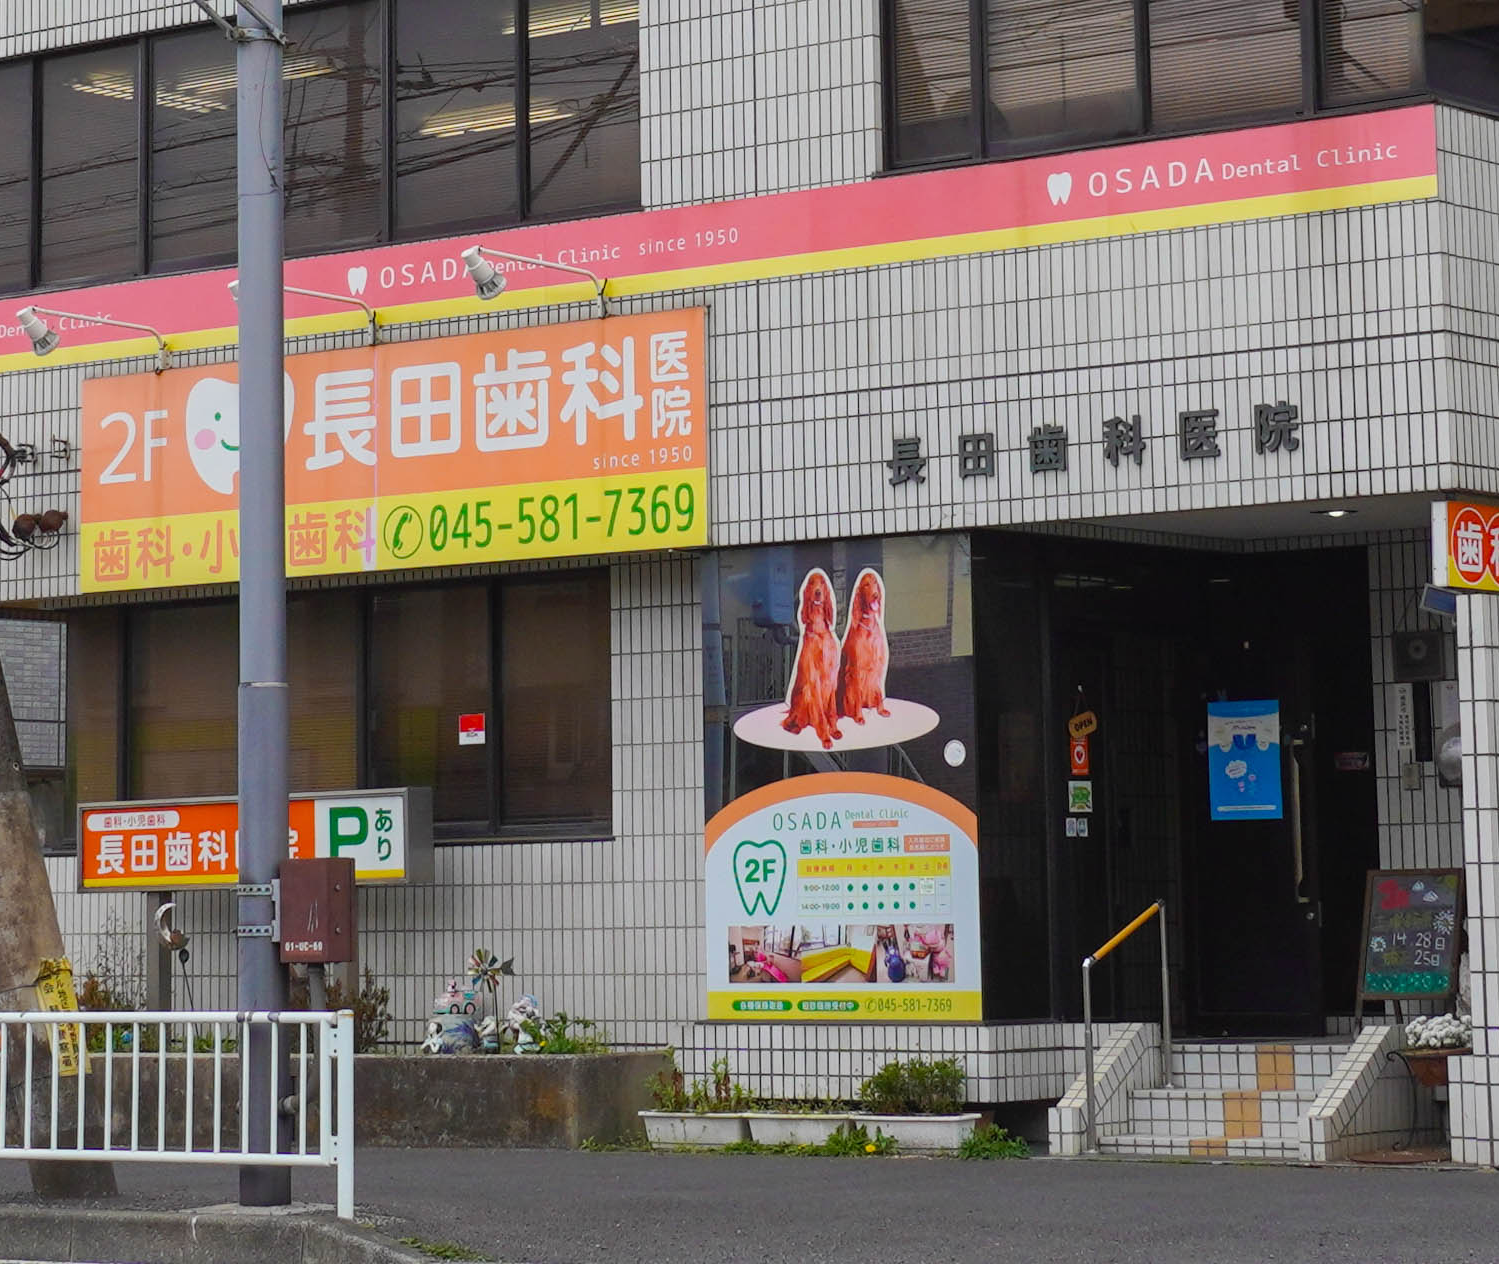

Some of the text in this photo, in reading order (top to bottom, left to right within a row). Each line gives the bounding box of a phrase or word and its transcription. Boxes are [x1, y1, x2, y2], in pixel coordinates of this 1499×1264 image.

[1088, 141, 1398, 197] OSADA Dental Clinic
[380, 257, 469, 289] OSAD
[557, 244, 621, 266] Clinic
[638, 237, 686, 257] since
[694, 227, 739, 249] 1950
[98, 335, 644, 485] 2F 長田歯科
[649, 330, 692, 440] 医院
[592, 445, 694, 471] since 1950
[887, 400, 1300, 486] 長田歯科医院
[94, 507, 376, 583] 歯科・小歯科
[428, 483, 695, 553] 045-581-7369
[1073, 717, 1094, 732] OPEN
[103, 814, 167, 829] 歯科・小児歯科
[328, 806, 369, 858] P
[374, 807, 393, 863] あり
[772, 811, 842, 832] OSADA
[844, 809, 874, 820] Dental
[879, 808, 909, 819] Clinic
[800, 836, 900, 855] 歯科・小児歯科
[744, 858, 777, 883] 2F
[877, 997, 952, 1013] 045-581-7369
